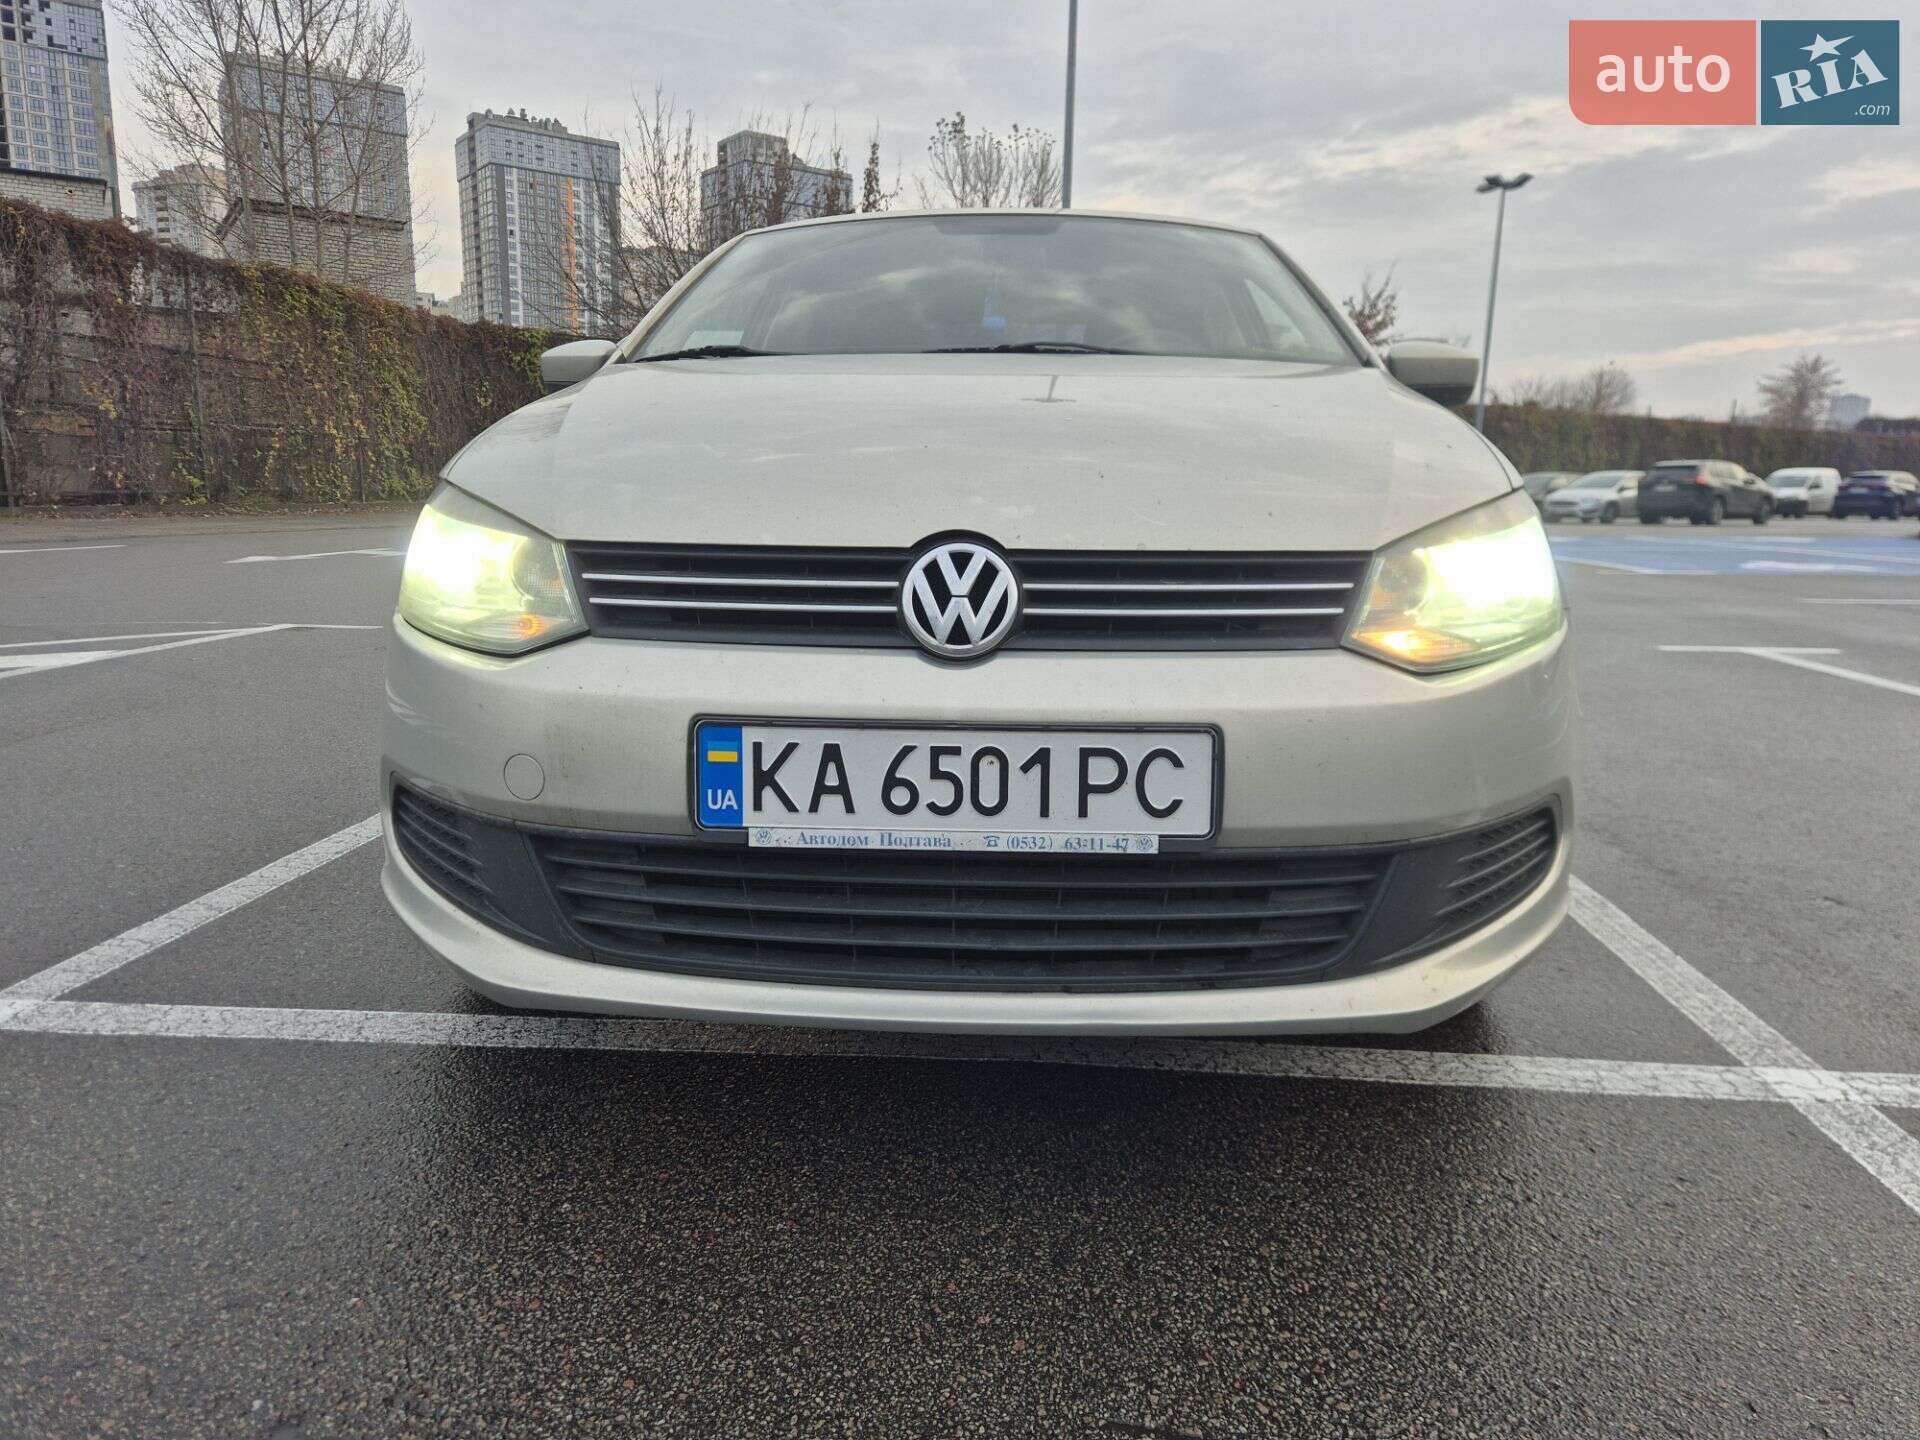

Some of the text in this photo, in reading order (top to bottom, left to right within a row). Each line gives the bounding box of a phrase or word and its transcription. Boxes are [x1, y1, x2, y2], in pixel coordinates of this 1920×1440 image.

[752, 741, 1186, 821] KA 6501 PC
[707, 789, 738, 811] UA
[797, 831, 869, 847] Автодом
[879, 832, 952, 848] Полтава
[1007, 834, 1053, 850] (0532)
